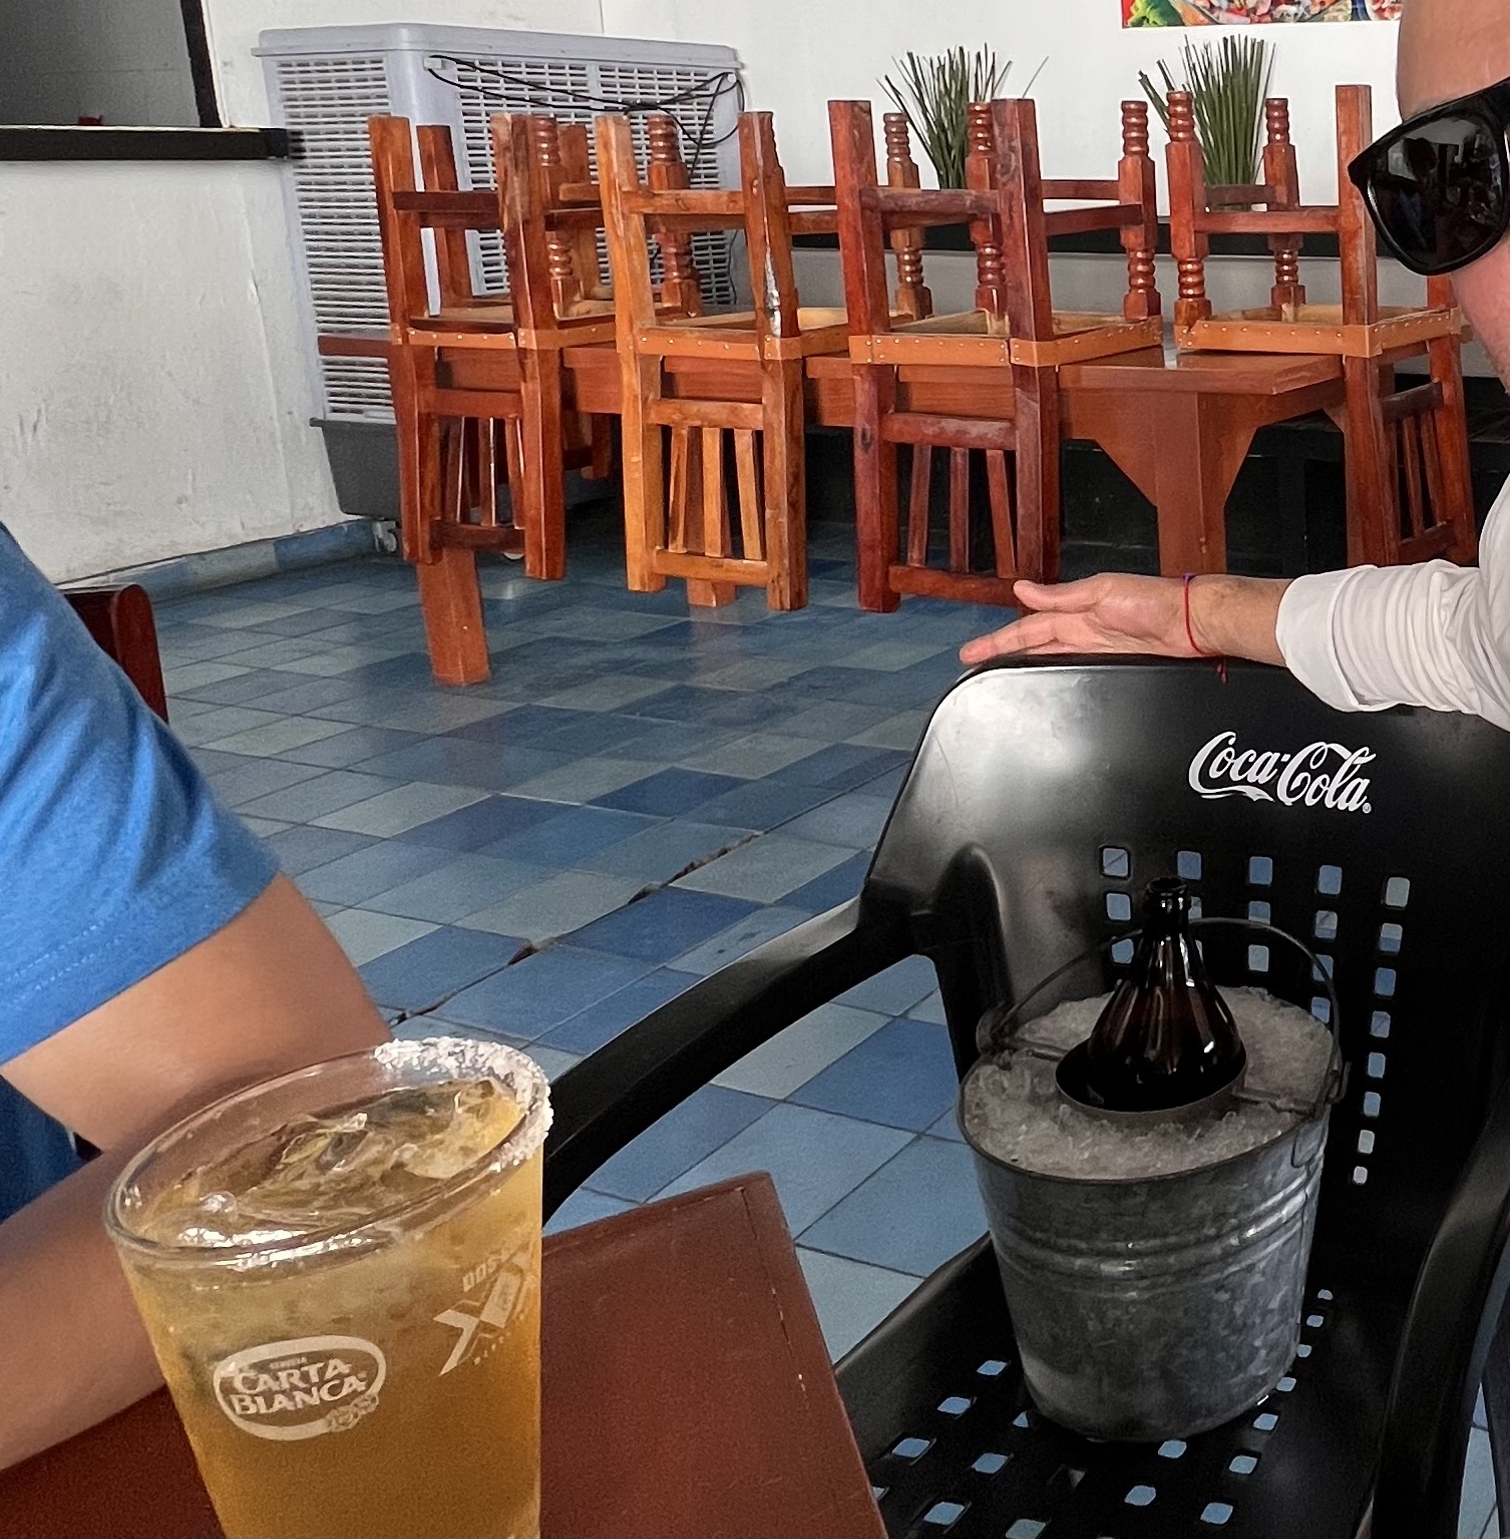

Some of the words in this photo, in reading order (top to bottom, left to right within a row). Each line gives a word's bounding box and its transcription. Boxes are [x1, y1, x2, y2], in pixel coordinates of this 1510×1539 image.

[1188, 731, 1377, 812] Coca-Cola
[229, 1375, 367, 1415] BLANCA
[233, 1358, 352, 1395] CARTA
